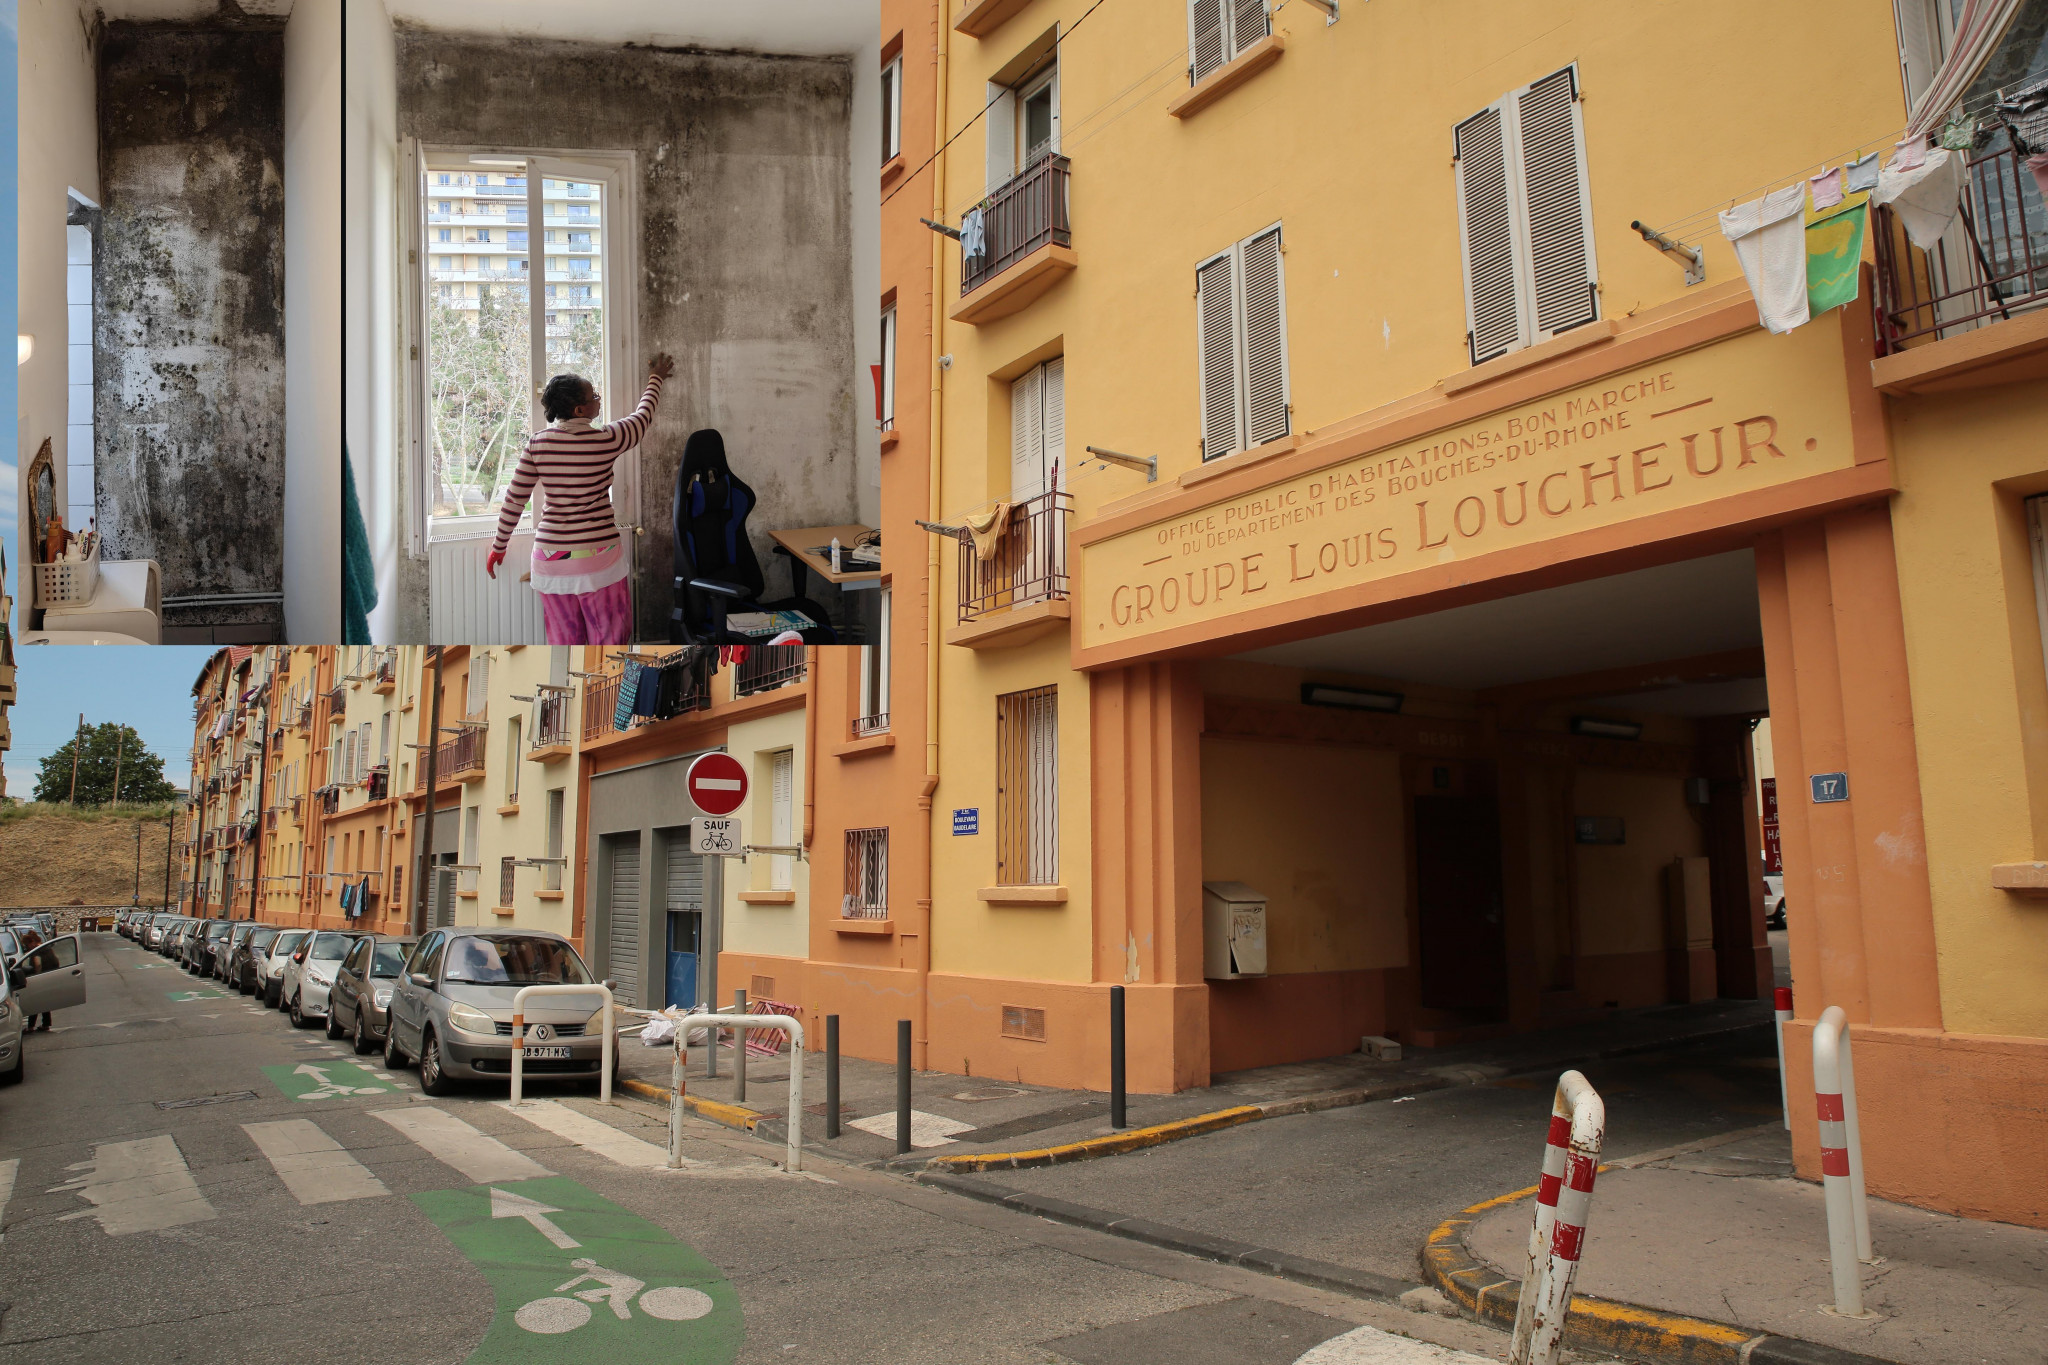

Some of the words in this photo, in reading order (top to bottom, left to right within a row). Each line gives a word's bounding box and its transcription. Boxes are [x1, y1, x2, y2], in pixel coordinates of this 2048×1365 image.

[1157, 515, 1216, 546] OFFICE
[1225, 490, 1297, 525] PUBLIC
[1507, 408, 1557, 440] BON
[1566, 371, 1675, 422] MARCHE
[1182, 539, 1201, 556] DU
[1206, 501, 1325, 549] DEPARTEMENT
[1335, 487, 1376, 513] DES
[1288, 527, 1398, 583] LOUIS
[1820, 779, 1838, 795] 17
[703, 820, 731, 830] SAUF
